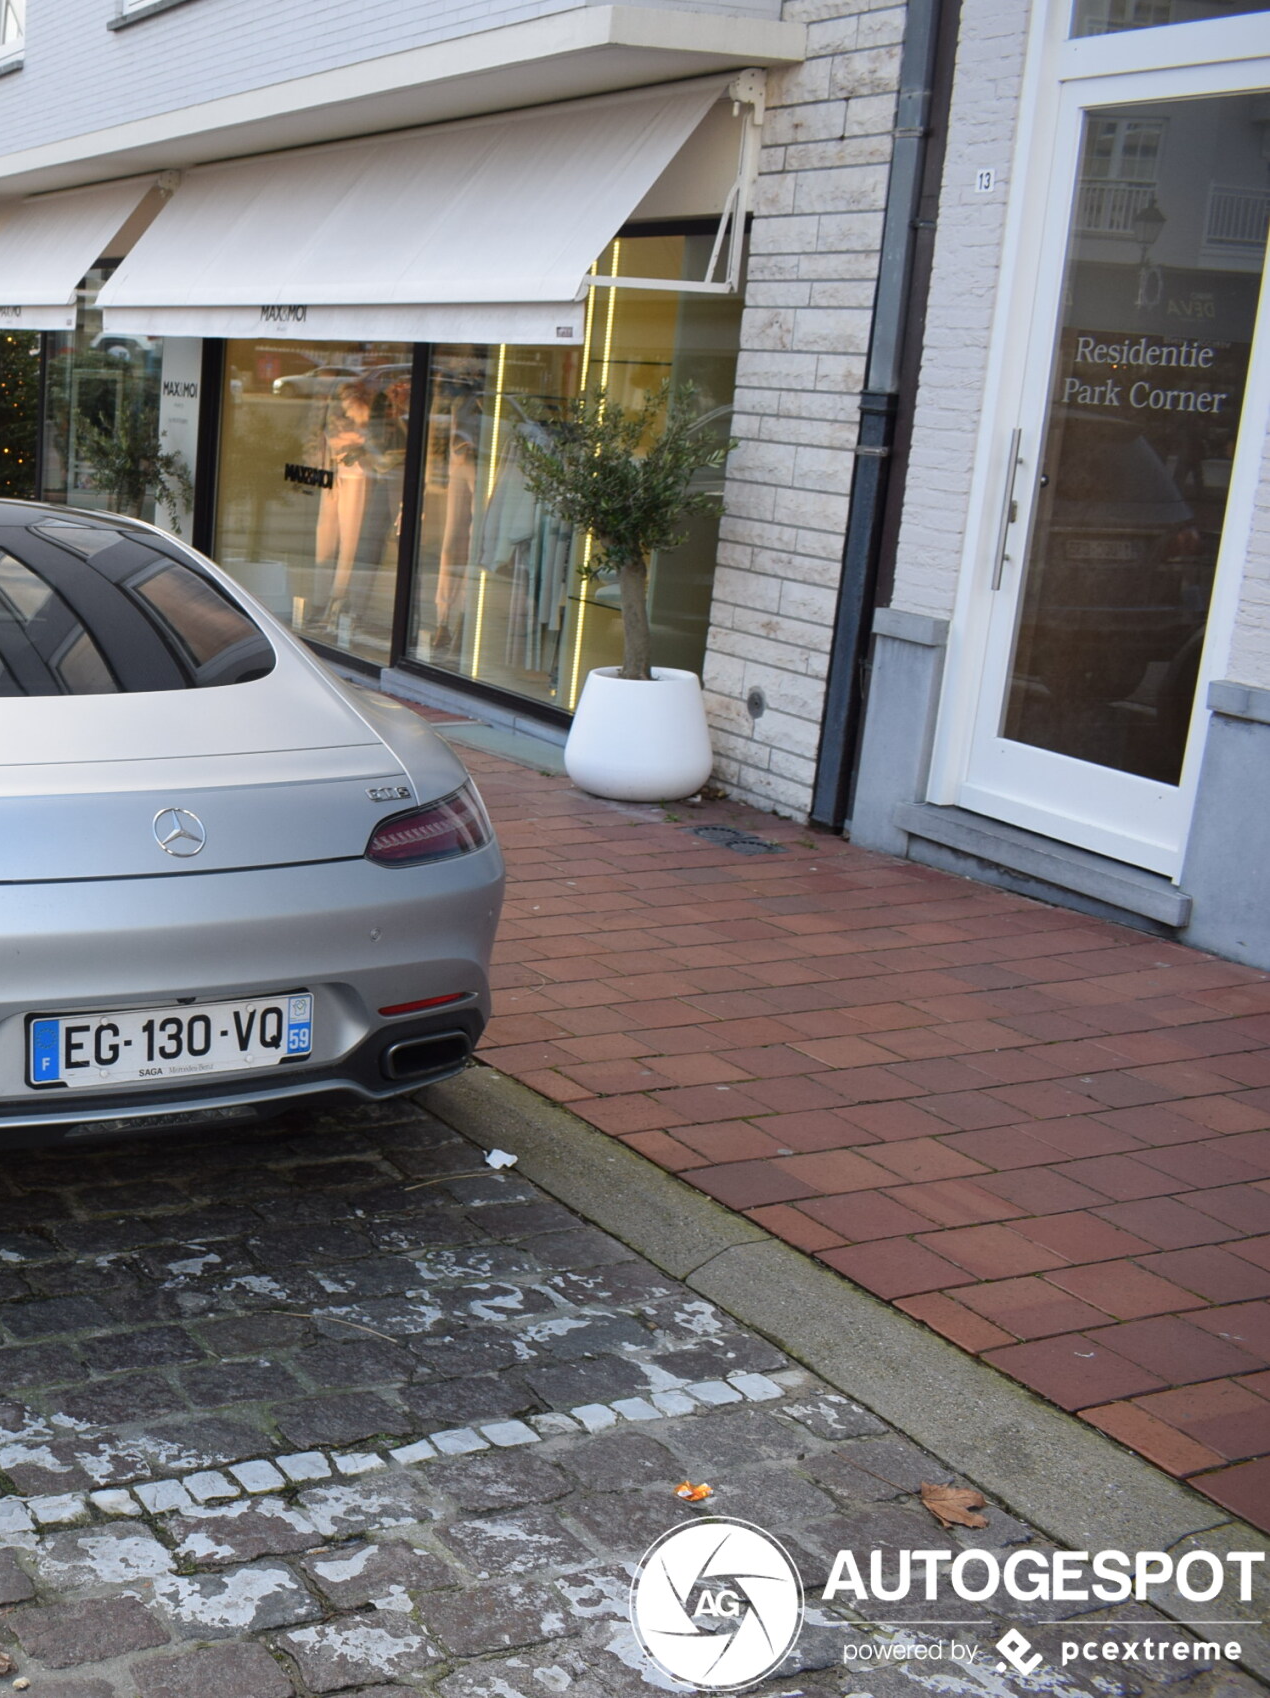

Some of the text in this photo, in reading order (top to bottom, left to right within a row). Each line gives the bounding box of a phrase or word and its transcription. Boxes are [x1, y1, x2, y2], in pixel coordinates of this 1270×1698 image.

[979, 172, 991, 190] 13
[1074, 337, 1214, 368] Residentie
[1061, 378, 1227, 413] Park Corner
[64, 1006, 284, 1069] EG-130-VQ
[288, 1028, 310, 1051] 59
[41, 1057, 51, 1071] F
[138, 1067, 163, 1077] SAGA
